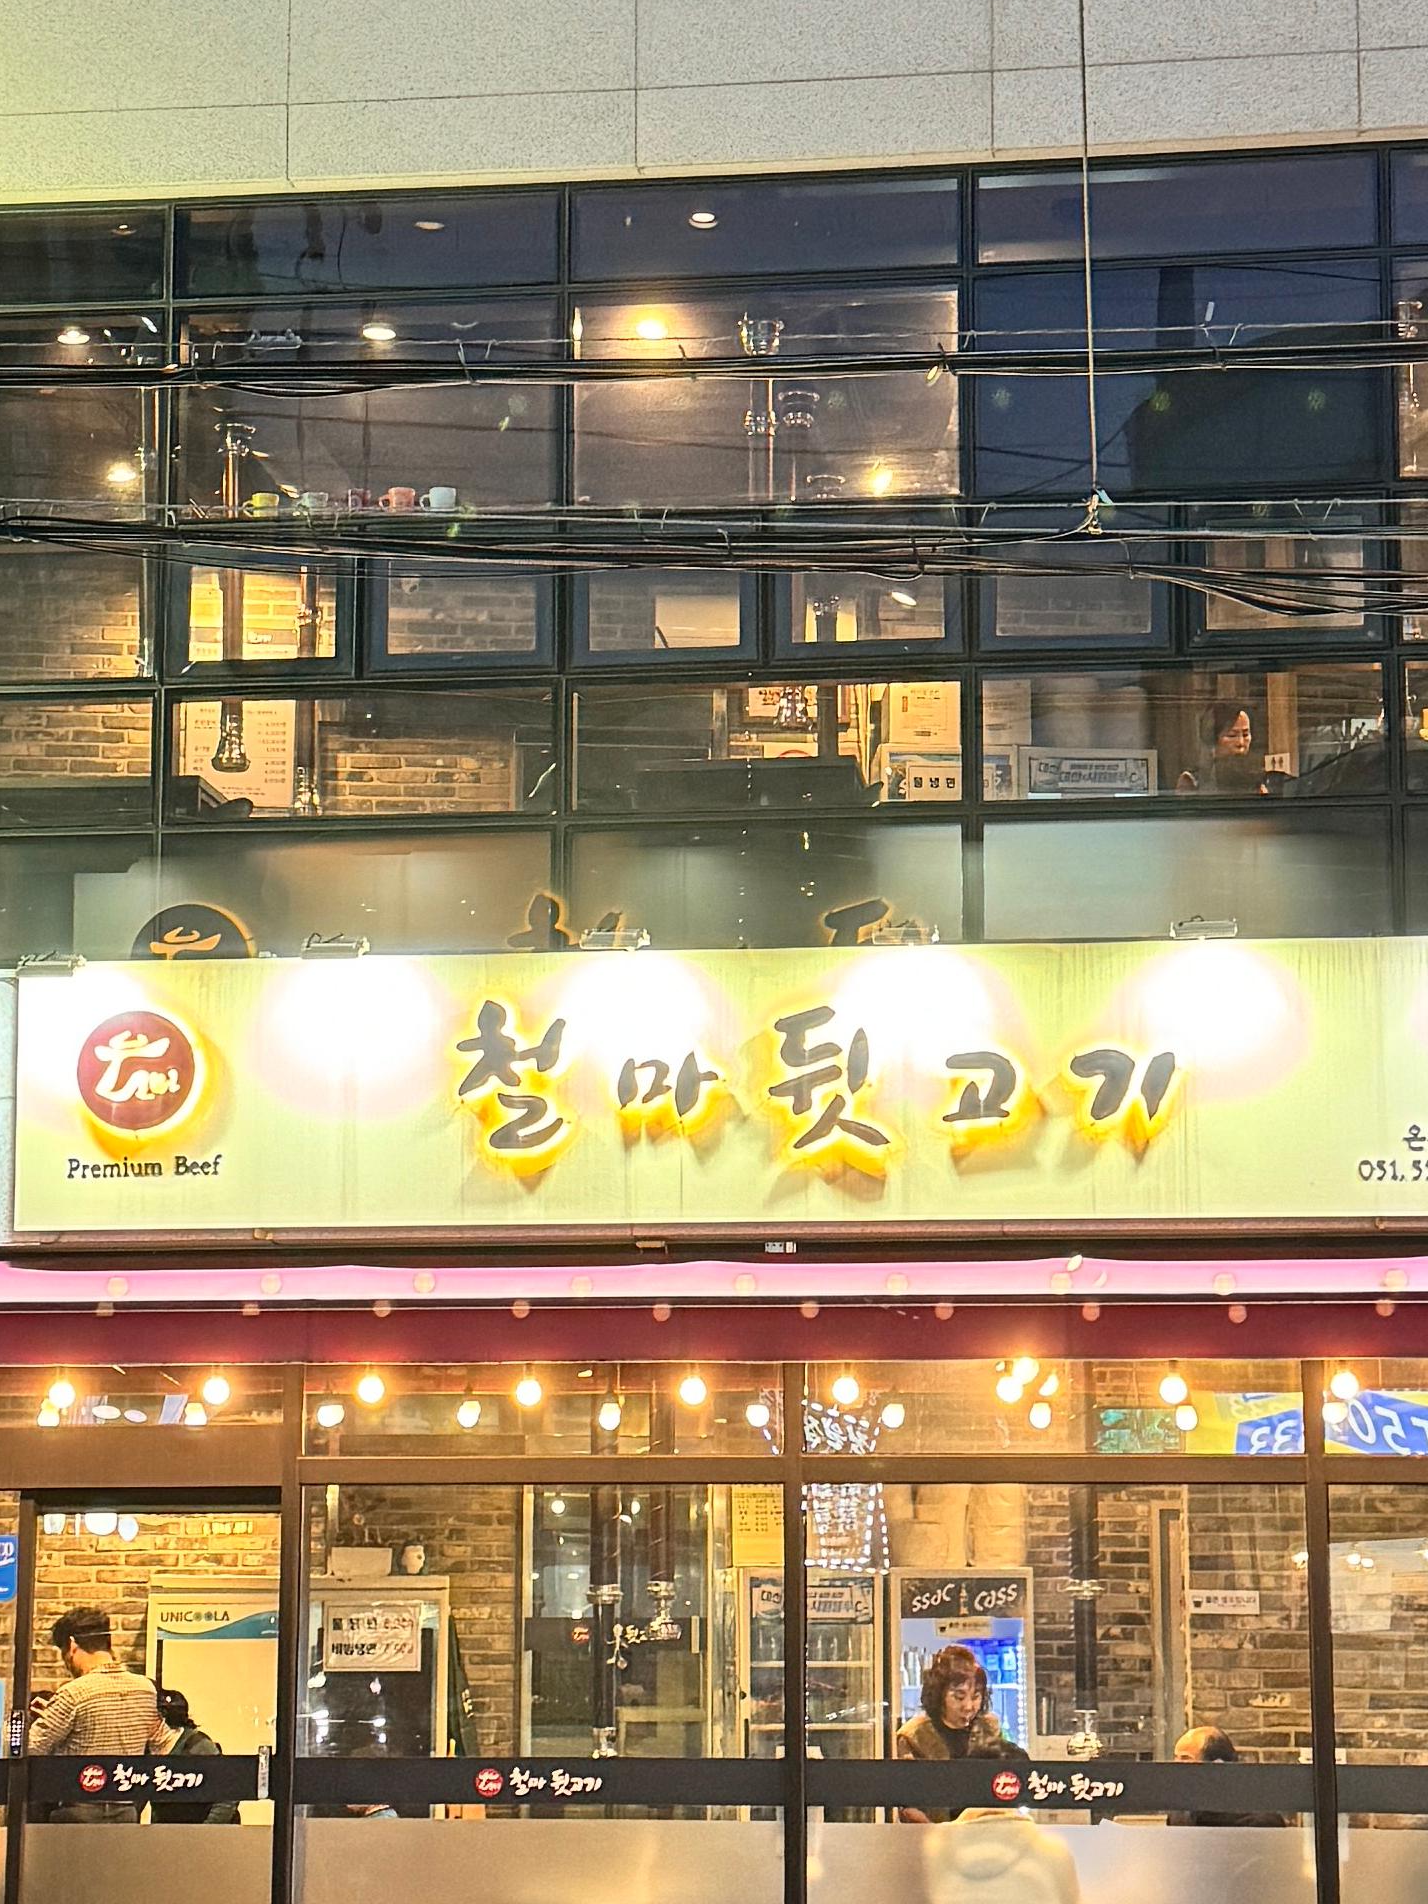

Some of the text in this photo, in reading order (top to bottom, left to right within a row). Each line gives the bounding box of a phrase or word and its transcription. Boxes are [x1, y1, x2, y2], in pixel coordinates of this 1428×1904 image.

[67, 1154, 223, 1179] Premium Beef
[112, 1763, 204, 1792] 철마 뒷고기
[509, 1767, 603, 1796] 철마 뒷고기
[1027, 1770, 1124, 1801] 철마 뒷고기
